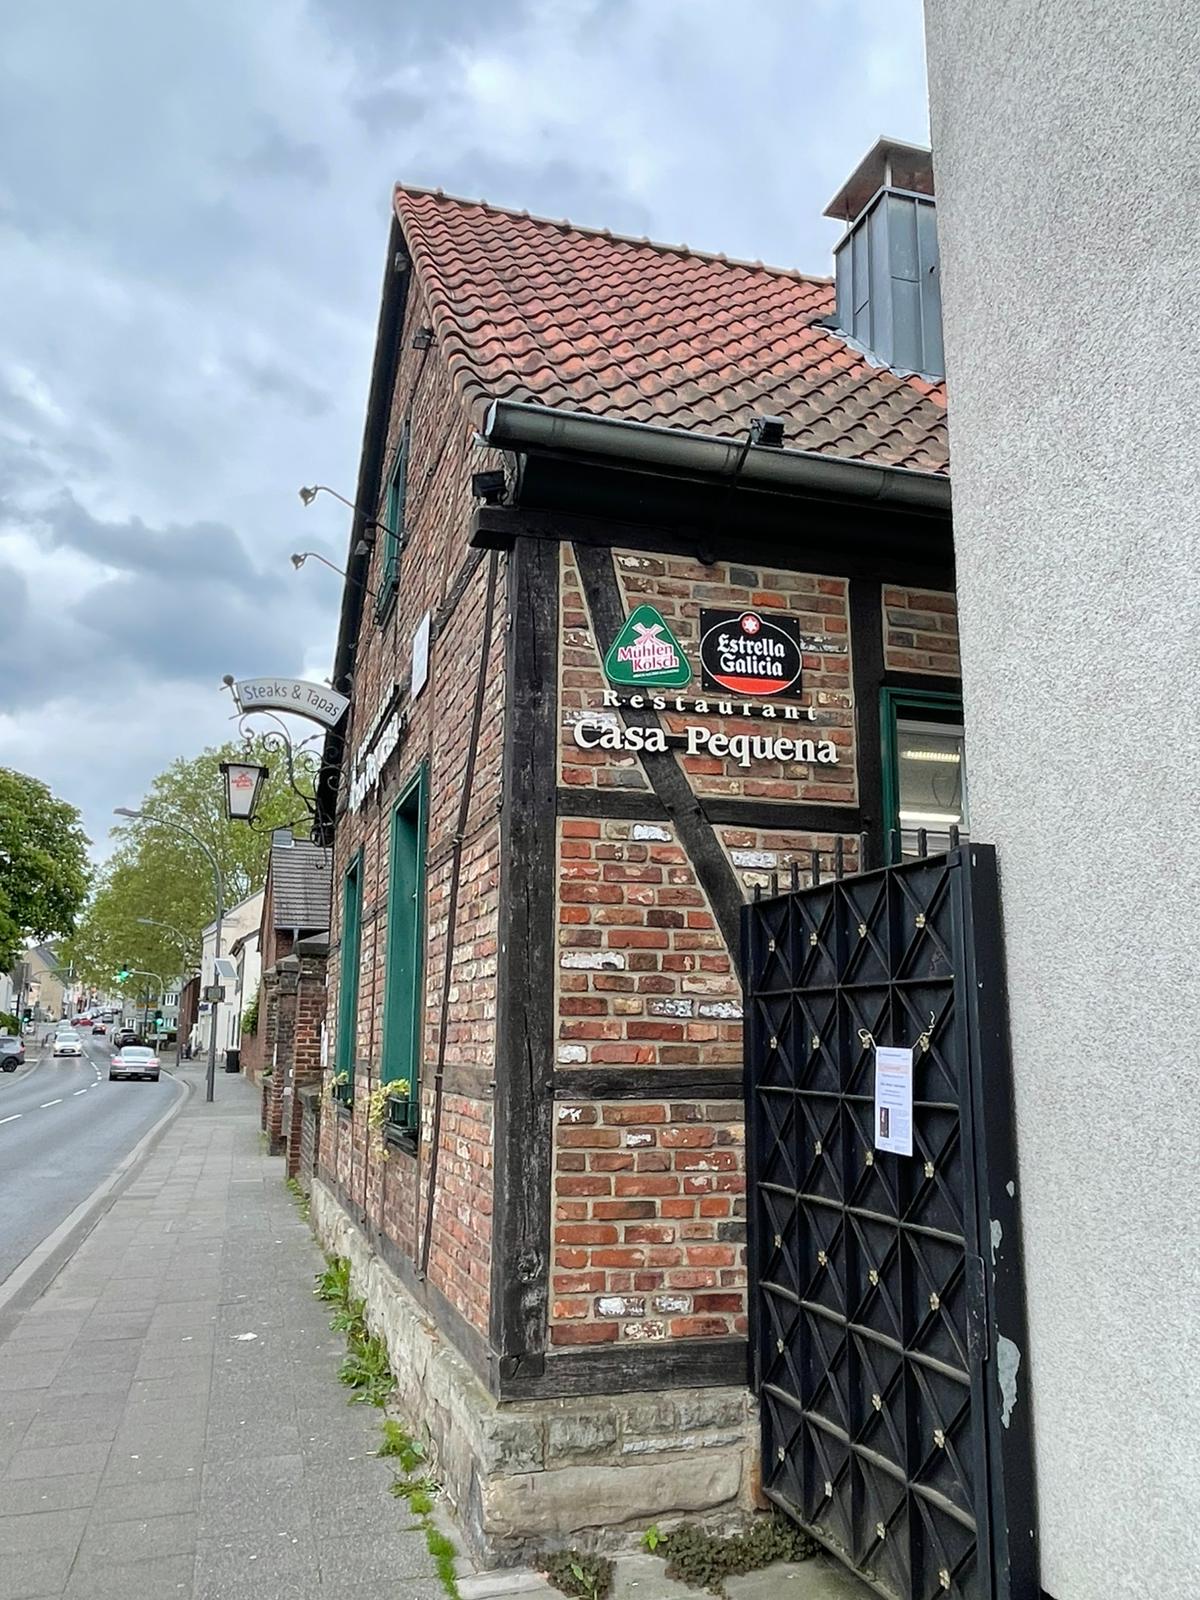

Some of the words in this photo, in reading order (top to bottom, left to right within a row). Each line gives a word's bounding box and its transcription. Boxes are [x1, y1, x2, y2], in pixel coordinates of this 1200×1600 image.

[717, 633, 785, 657] Estrella
[720, 653, 783, 676] Galicia
[244, 682, 287, 700] Steaks
[291, 684, 301, 699] &
[307, 688, 339, 716] Tapas
[602, 690, 817, 720] Restaurant
[573, 720, 668, 752] Casa
[686, 726, 839, 766] Pequena
